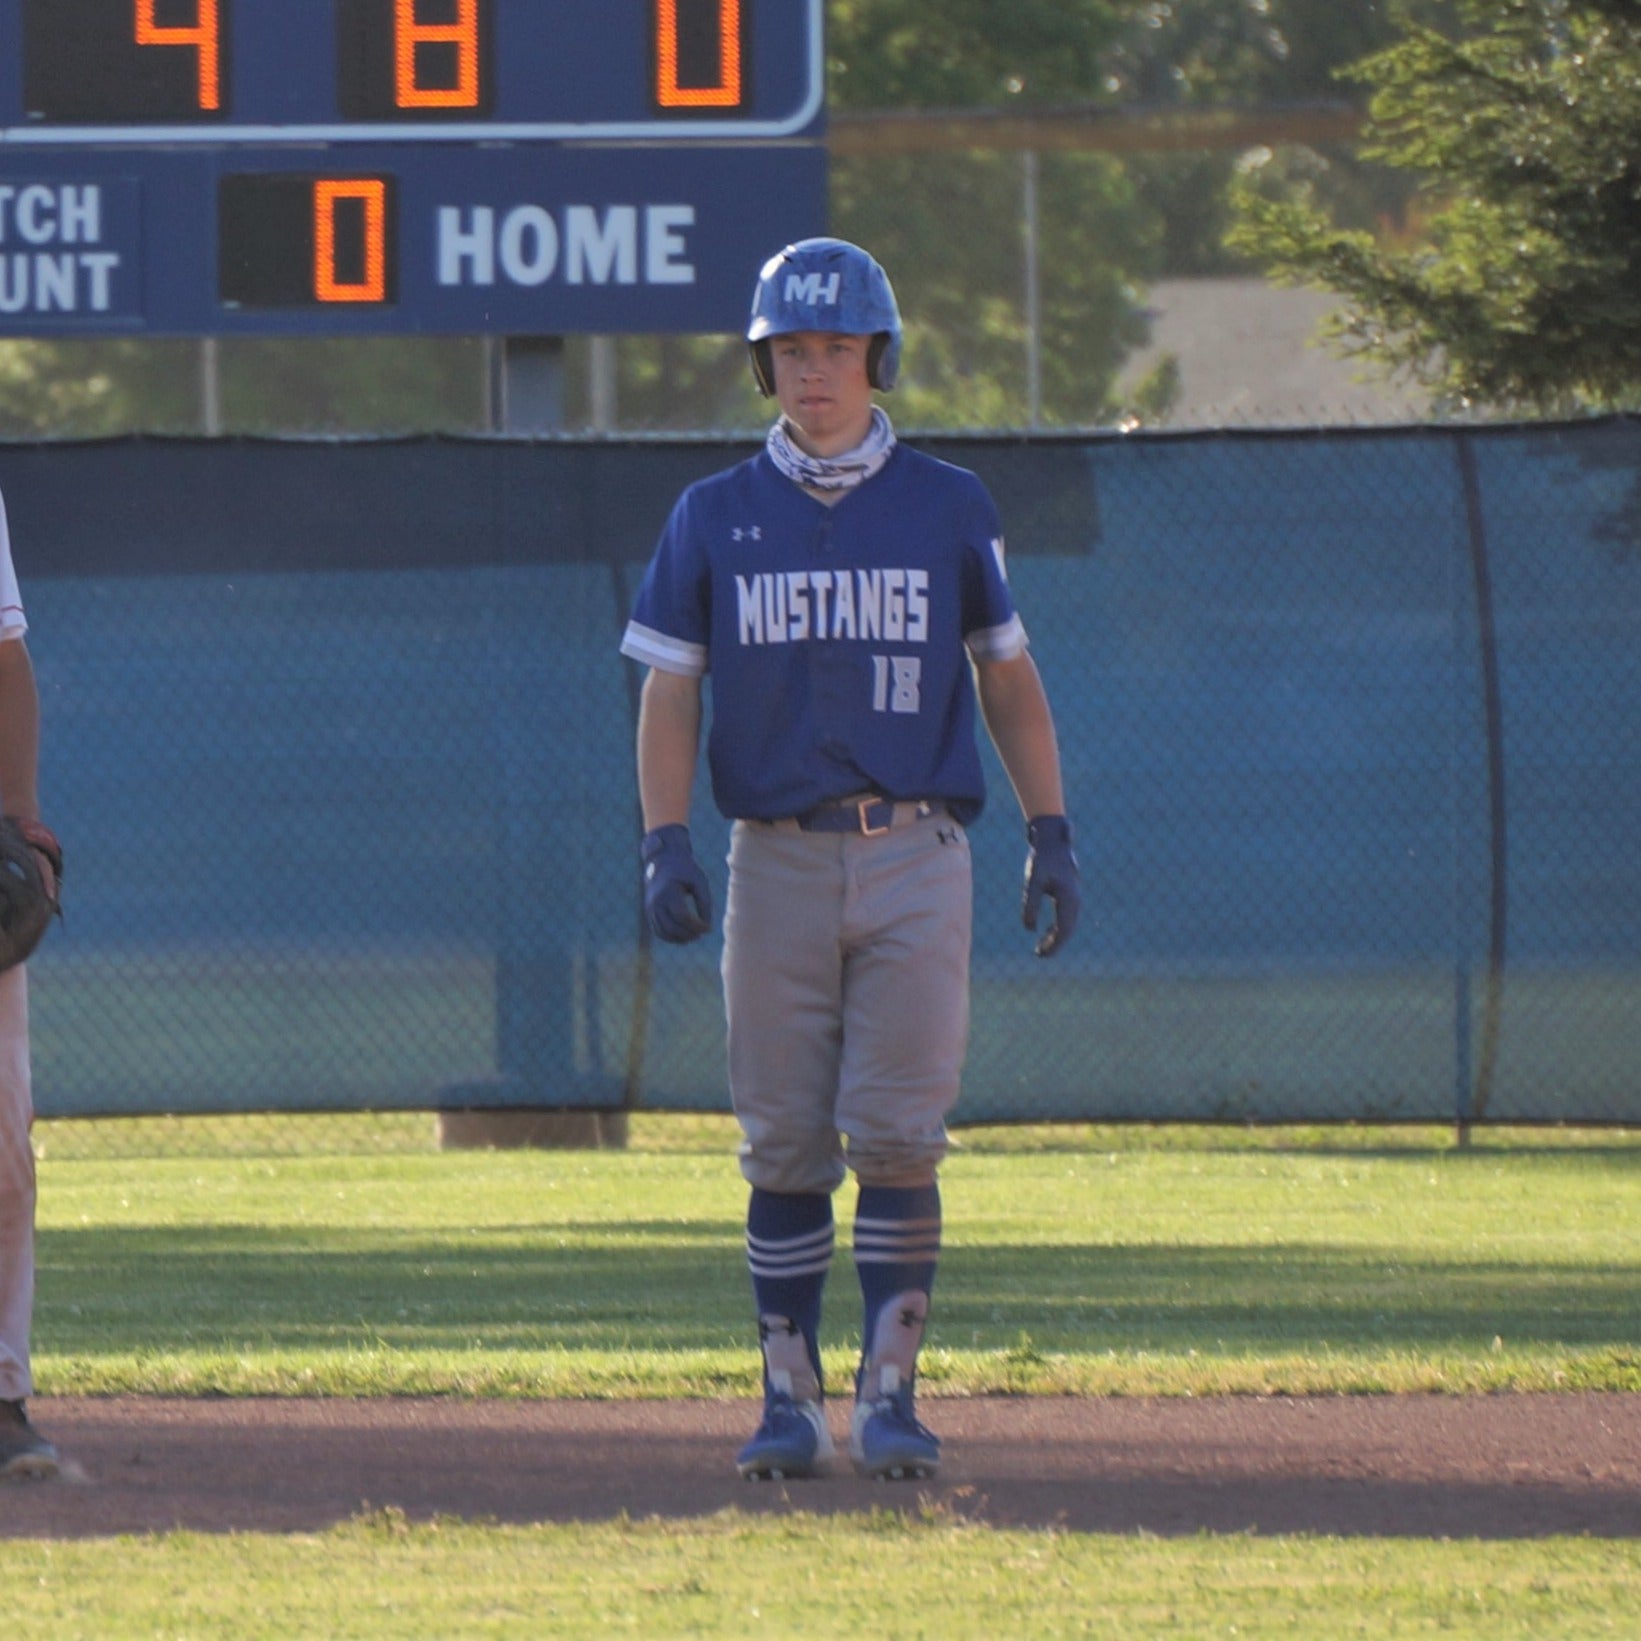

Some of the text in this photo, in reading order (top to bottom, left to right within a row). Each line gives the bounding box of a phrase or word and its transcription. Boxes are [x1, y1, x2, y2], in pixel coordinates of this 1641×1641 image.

[314, 180, 385, 301] 0
[437, 205, 695, 285] HOME
[783, 272, 840, 305] MH
[734, 568, 929, 645] MUSTANGS
[872, 655, 921, 713] 18
